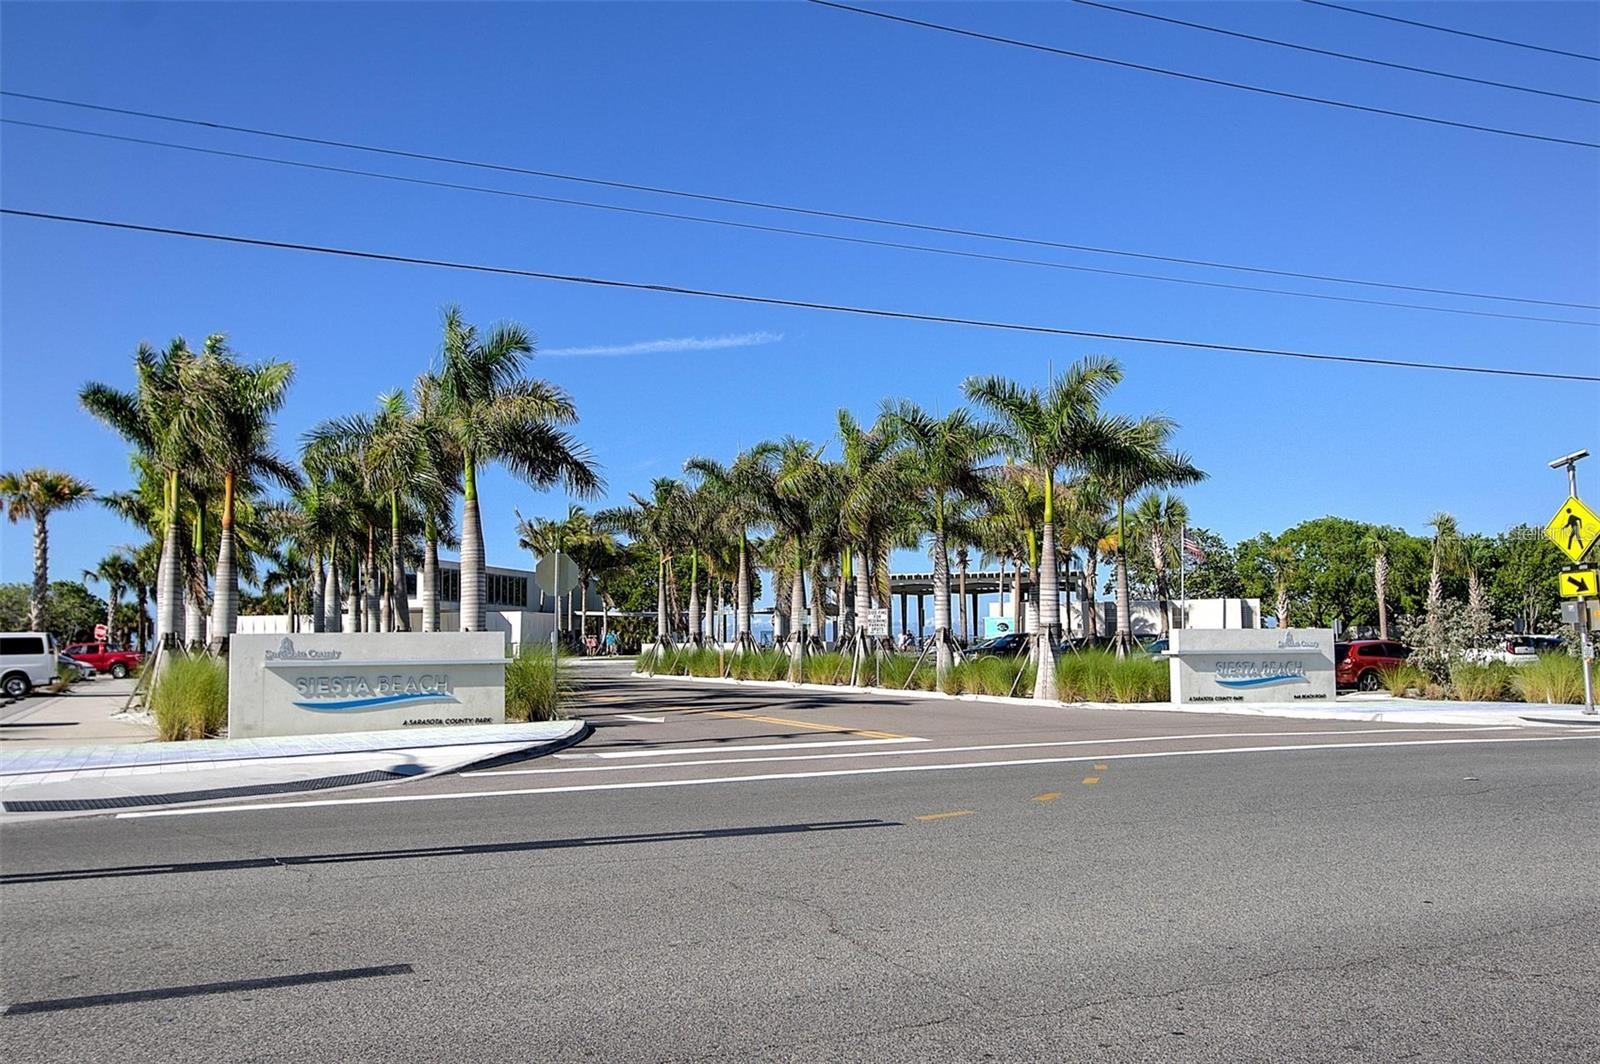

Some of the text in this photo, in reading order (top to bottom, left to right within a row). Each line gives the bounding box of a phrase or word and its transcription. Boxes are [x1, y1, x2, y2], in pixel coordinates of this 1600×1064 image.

[308, 648, 342, 660] County
[1215, 660, 1304, 675] SIESTA BEACH
[296, 673, 449, 695] SIESTA BEACH
[409, 718, 443, 726] SARASOTA
